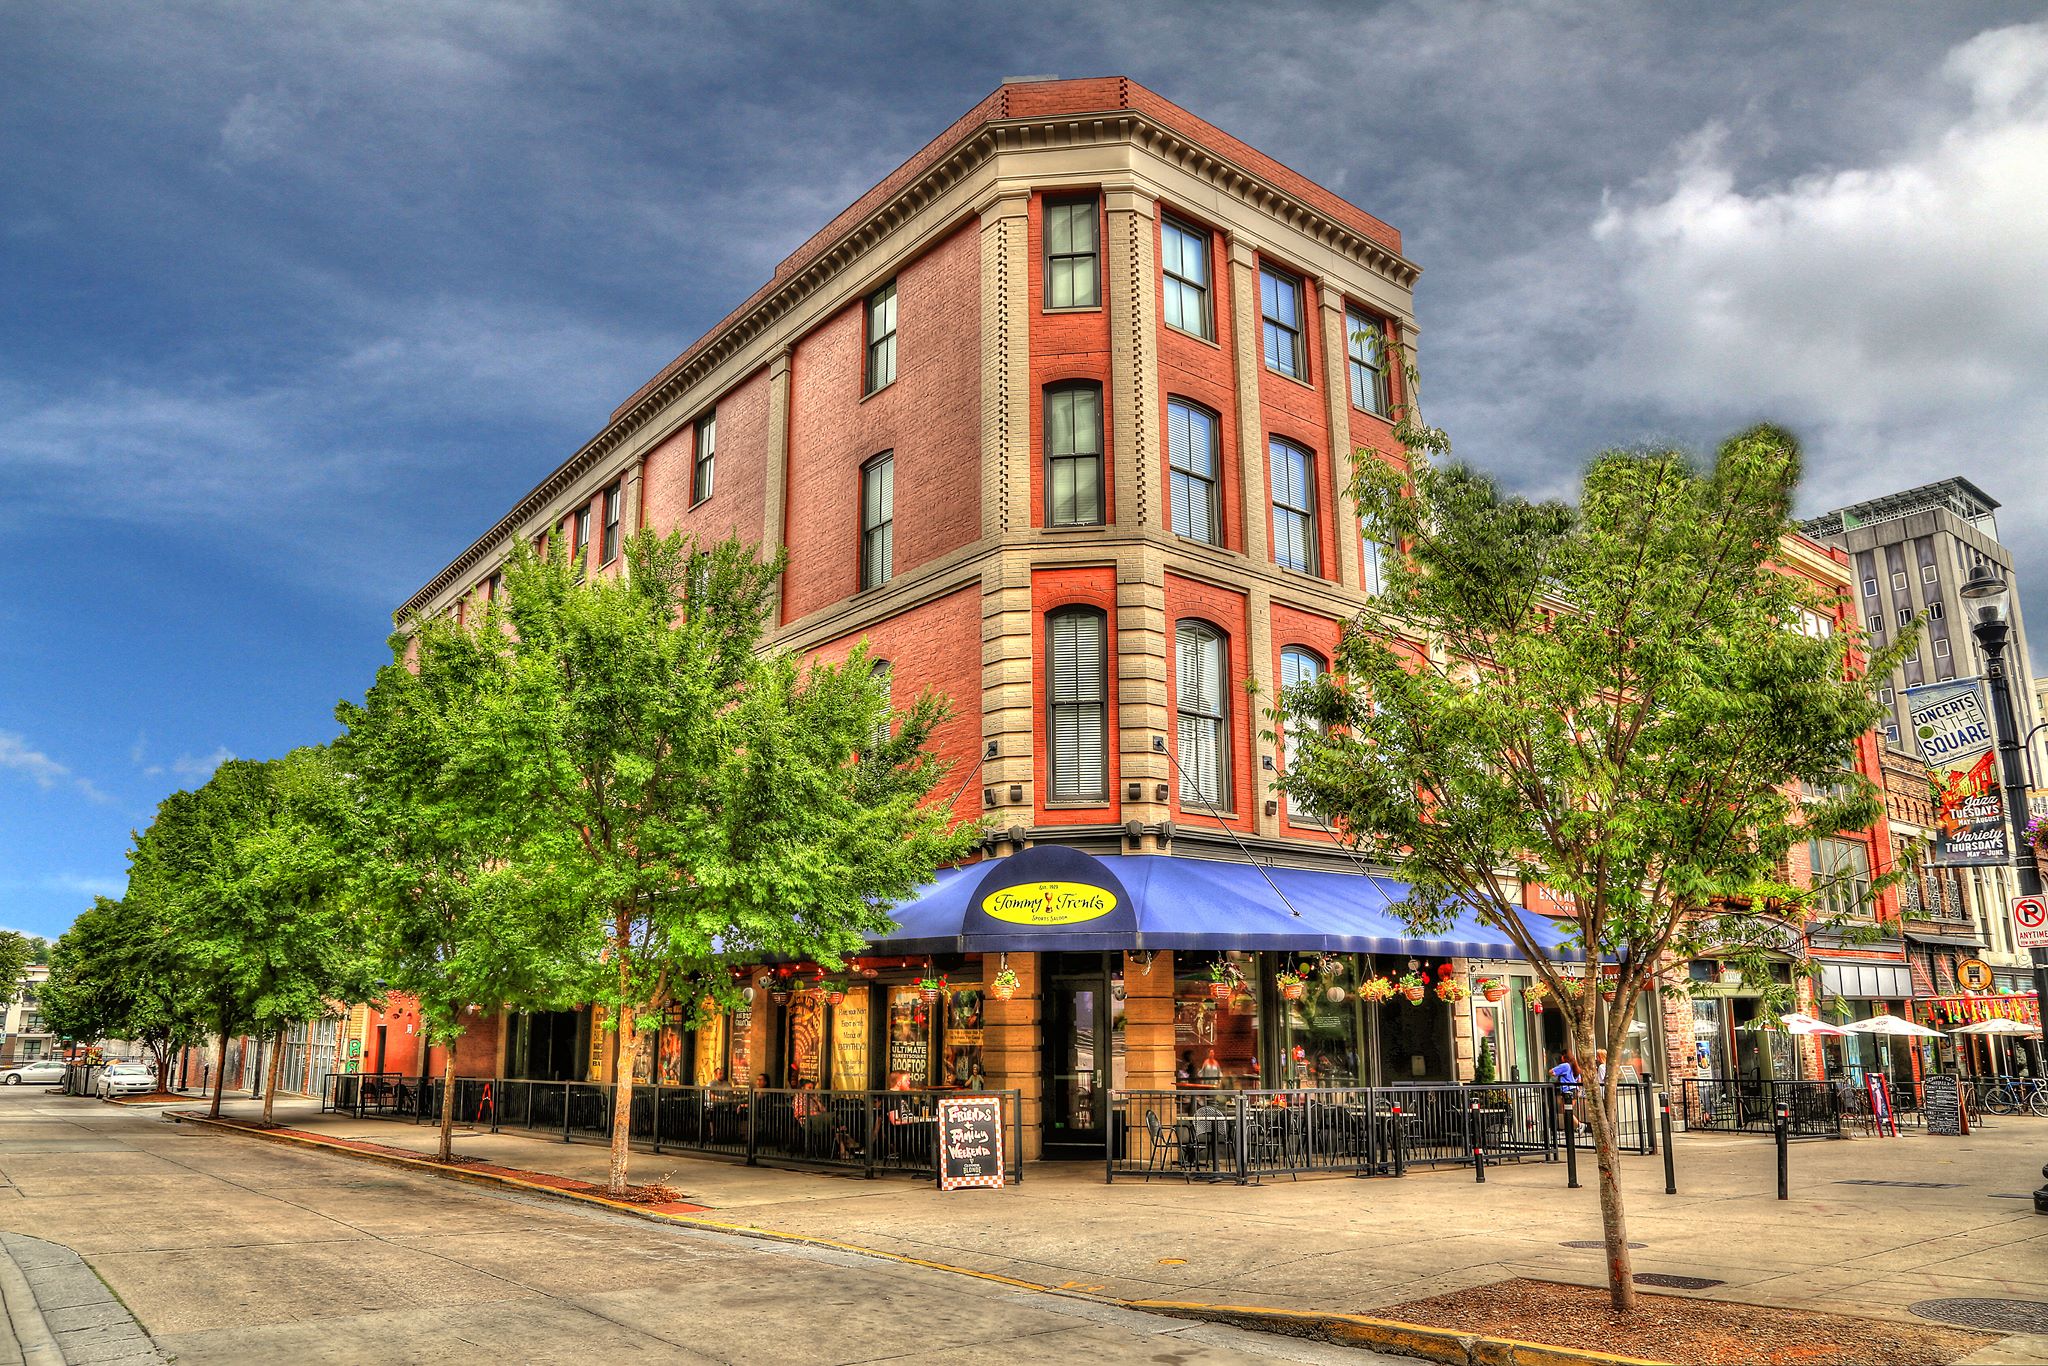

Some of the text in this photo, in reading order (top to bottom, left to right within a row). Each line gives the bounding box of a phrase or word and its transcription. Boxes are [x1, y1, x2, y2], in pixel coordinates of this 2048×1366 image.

[1912, 696, 1975, 727] CONCERTS
[1946, 708, 1982, 729] THE
[1923, 721, 1991, 757] SQUARE
[1963, 795, 1998, 811] Jazz
[1949, 804, 2000, 820] TUESDAYS
[1958, 818, 1971, 826] MAY
[1976, 815, 2000, 824] AUGUST
[1952, 828, 2005, 843] Variety
[1945, 839, 2004, 853] THURSDAYS
[993, 893, 1104, 913] Tommy Trent's
[2019, 930, 2048, 940] ANYTIME
[892, 1046, 927, 1054] ULTIMATE
[892, 1058, 926, 1073] ROOFTOP
